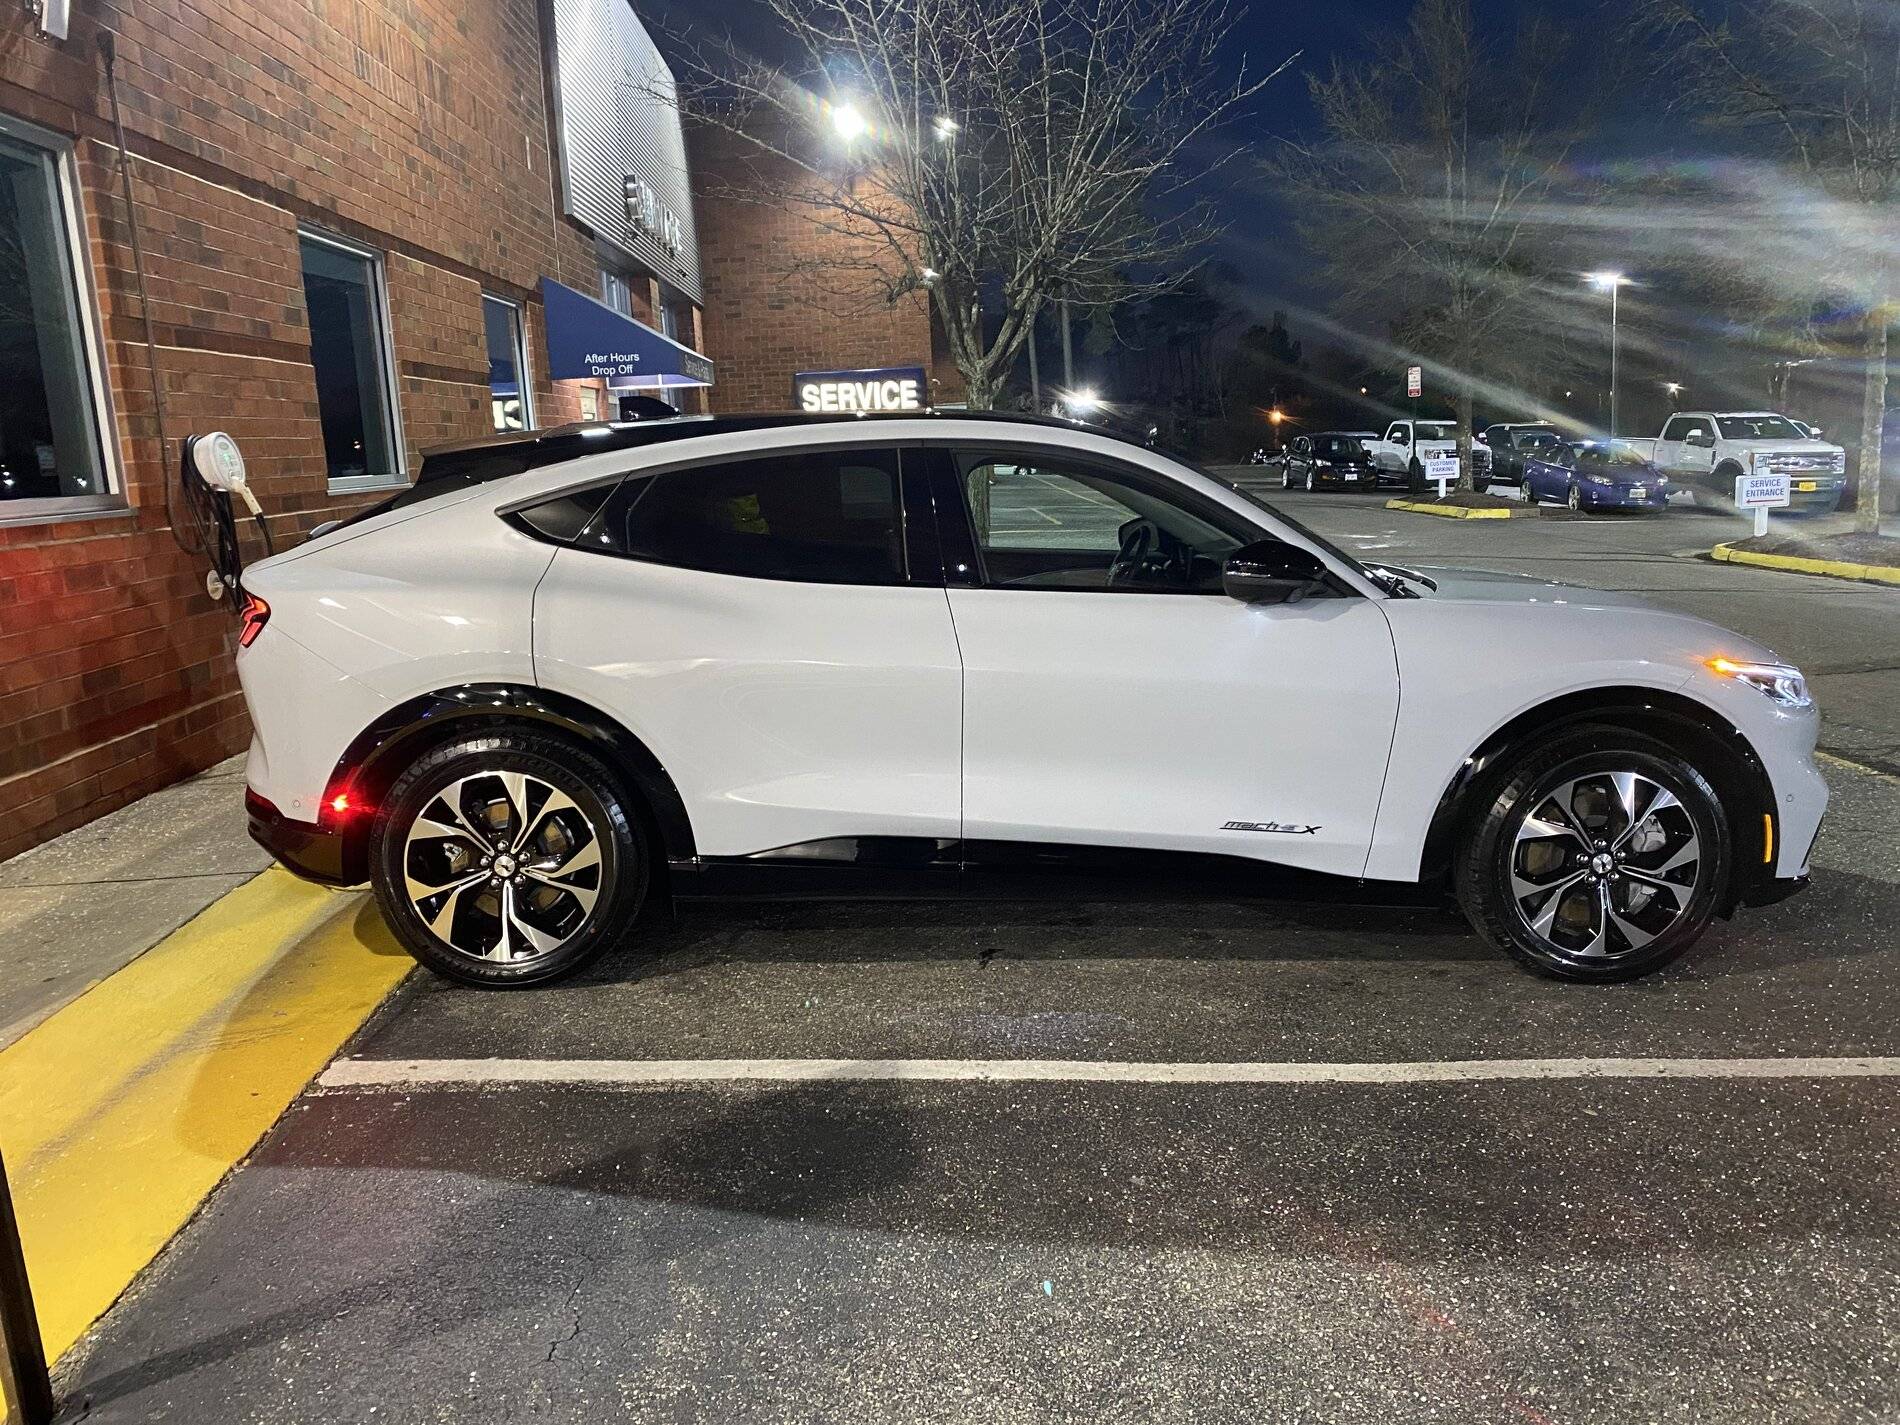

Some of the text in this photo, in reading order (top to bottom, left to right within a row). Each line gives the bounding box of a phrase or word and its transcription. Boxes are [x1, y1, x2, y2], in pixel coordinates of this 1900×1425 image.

[584, 352, 640, 364] After Hours
[592, 364, 633, 377] Drop Off
[801, 379, 919, 412] SERVICE
[1750, 478, 1781, 488] SERVICE
[1746, 488, 1785, 498] ENTRANCE
